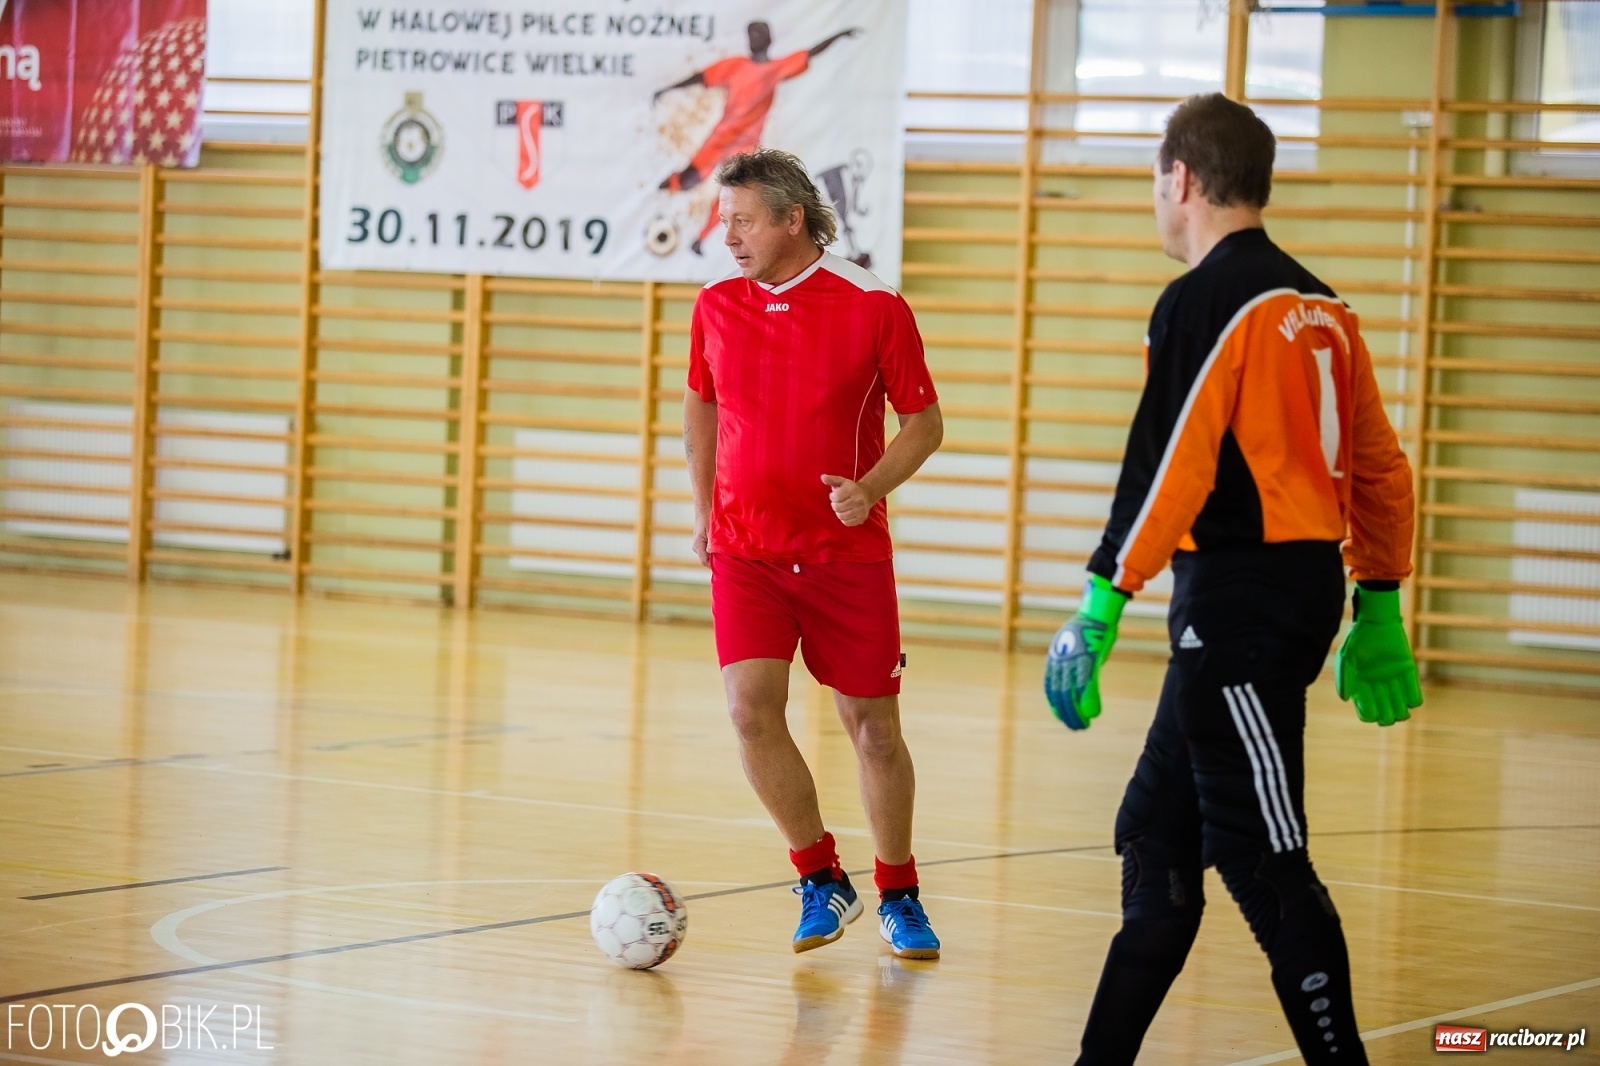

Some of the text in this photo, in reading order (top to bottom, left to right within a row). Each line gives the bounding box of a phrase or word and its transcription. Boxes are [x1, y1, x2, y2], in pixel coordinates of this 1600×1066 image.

[358, 9, 381, 30] W
[391, 10, 511, 39] HALOWEJ
[606, 8, 714, 42] NOŻNEJ
[355, 50, 635, 77] PIETROWICE WIELKIE
[347, 207, 608, 255] 30.11.2019
[765, 302, 790, 313] JAKO
[1311, 347, 1344, 478] 1
